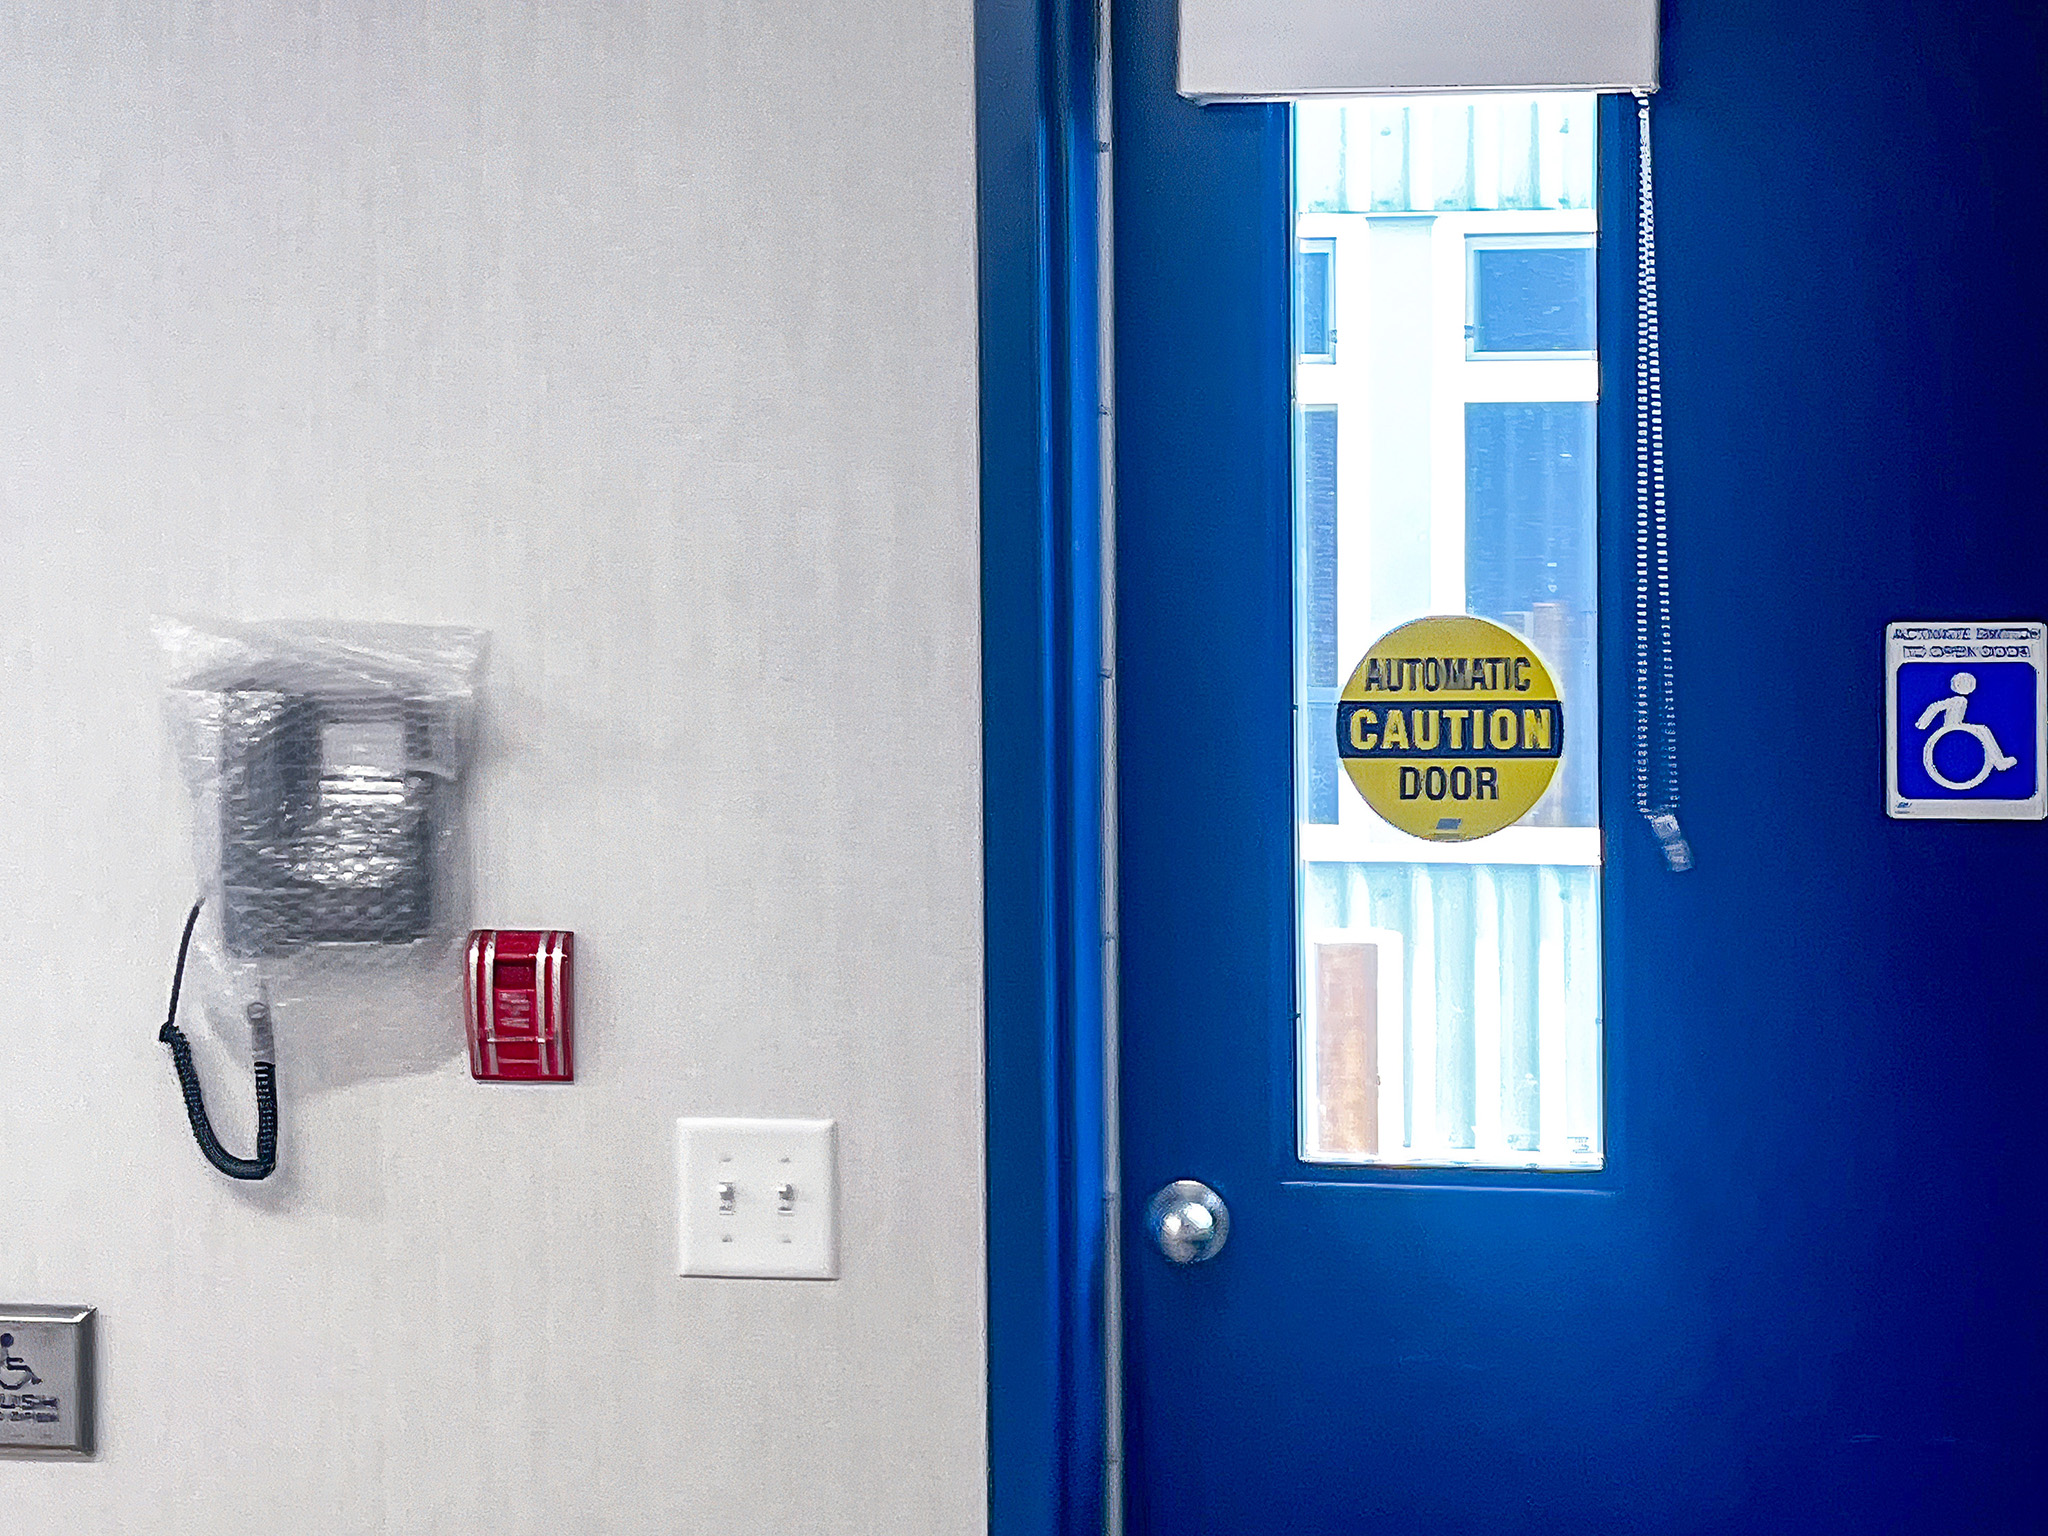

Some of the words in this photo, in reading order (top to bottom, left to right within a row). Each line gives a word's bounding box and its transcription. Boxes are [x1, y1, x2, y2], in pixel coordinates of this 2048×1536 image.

[1365, 657, 1531, 691] AUTOMATIC
[1350, 708, 1552, 751] CAUTION
[1399, 766, 1499, 800] DOOR
